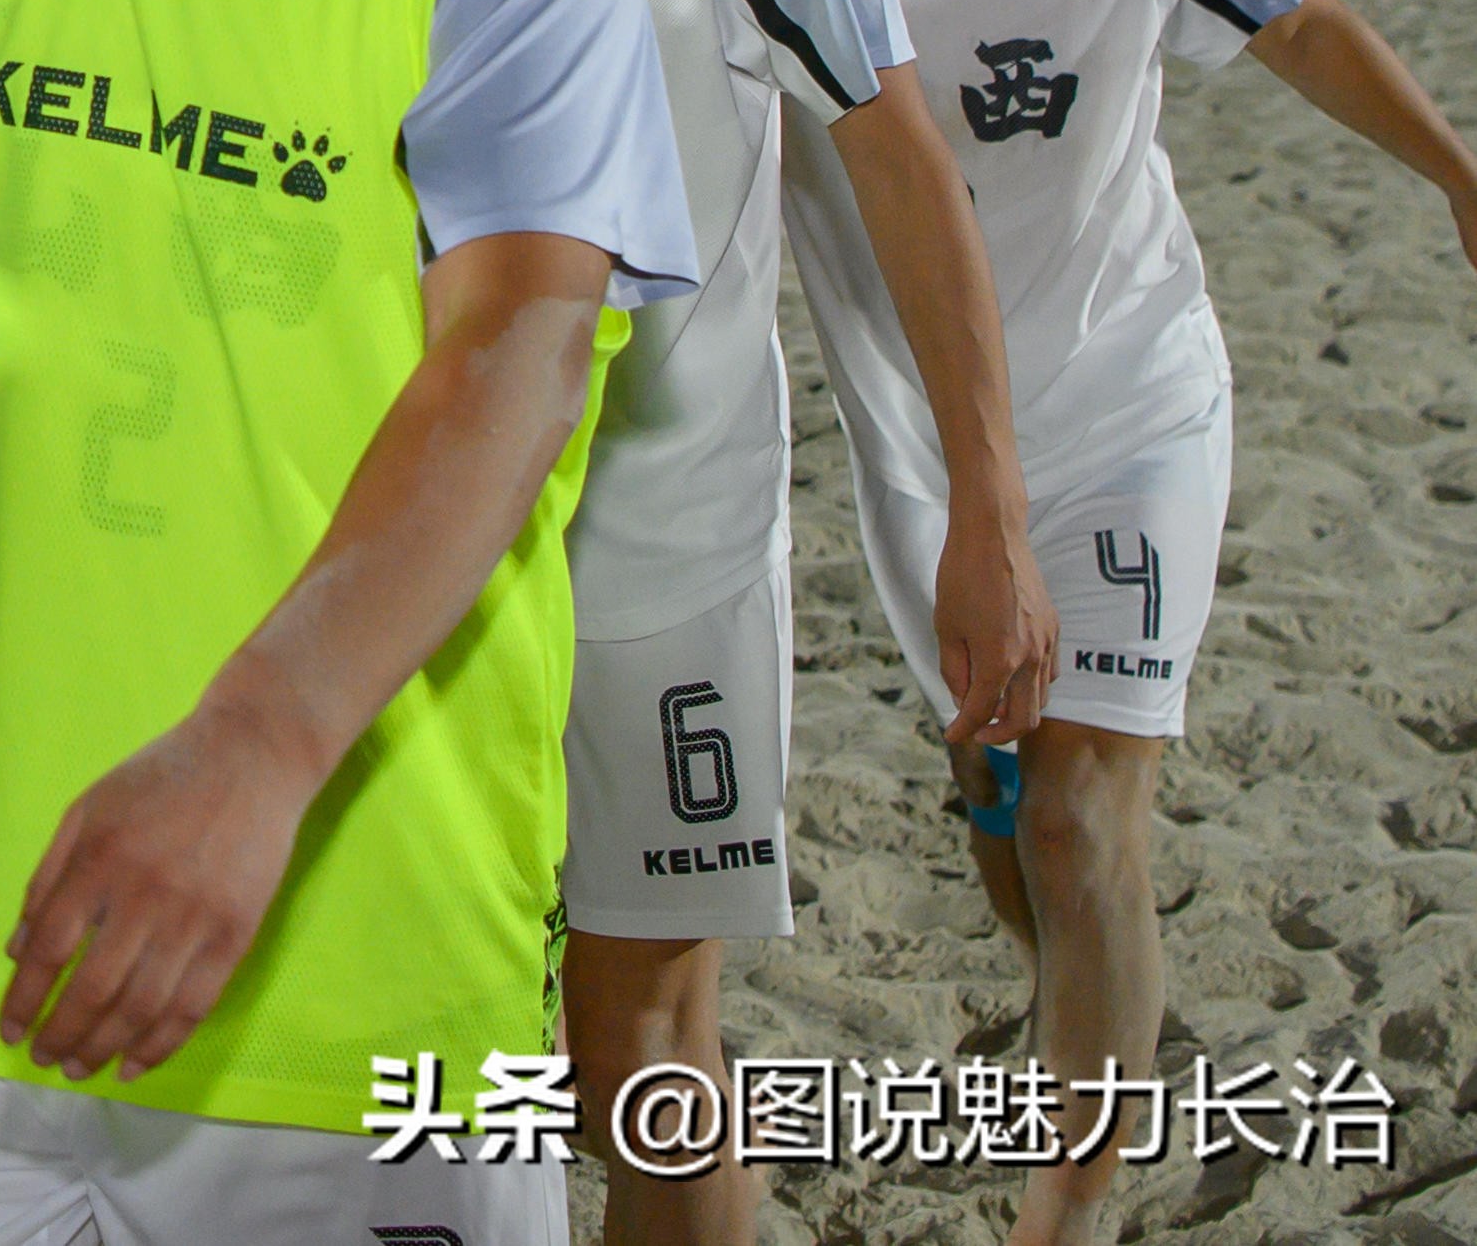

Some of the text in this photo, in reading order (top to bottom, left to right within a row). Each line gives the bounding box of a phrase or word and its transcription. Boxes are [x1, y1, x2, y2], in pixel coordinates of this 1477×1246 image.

[1094, 529, 1161, 640] 4
[1075, 650, 1173, 680] KELME
[659, 680, 739, 824] 6
[643, 838, 776, 876] KELME
